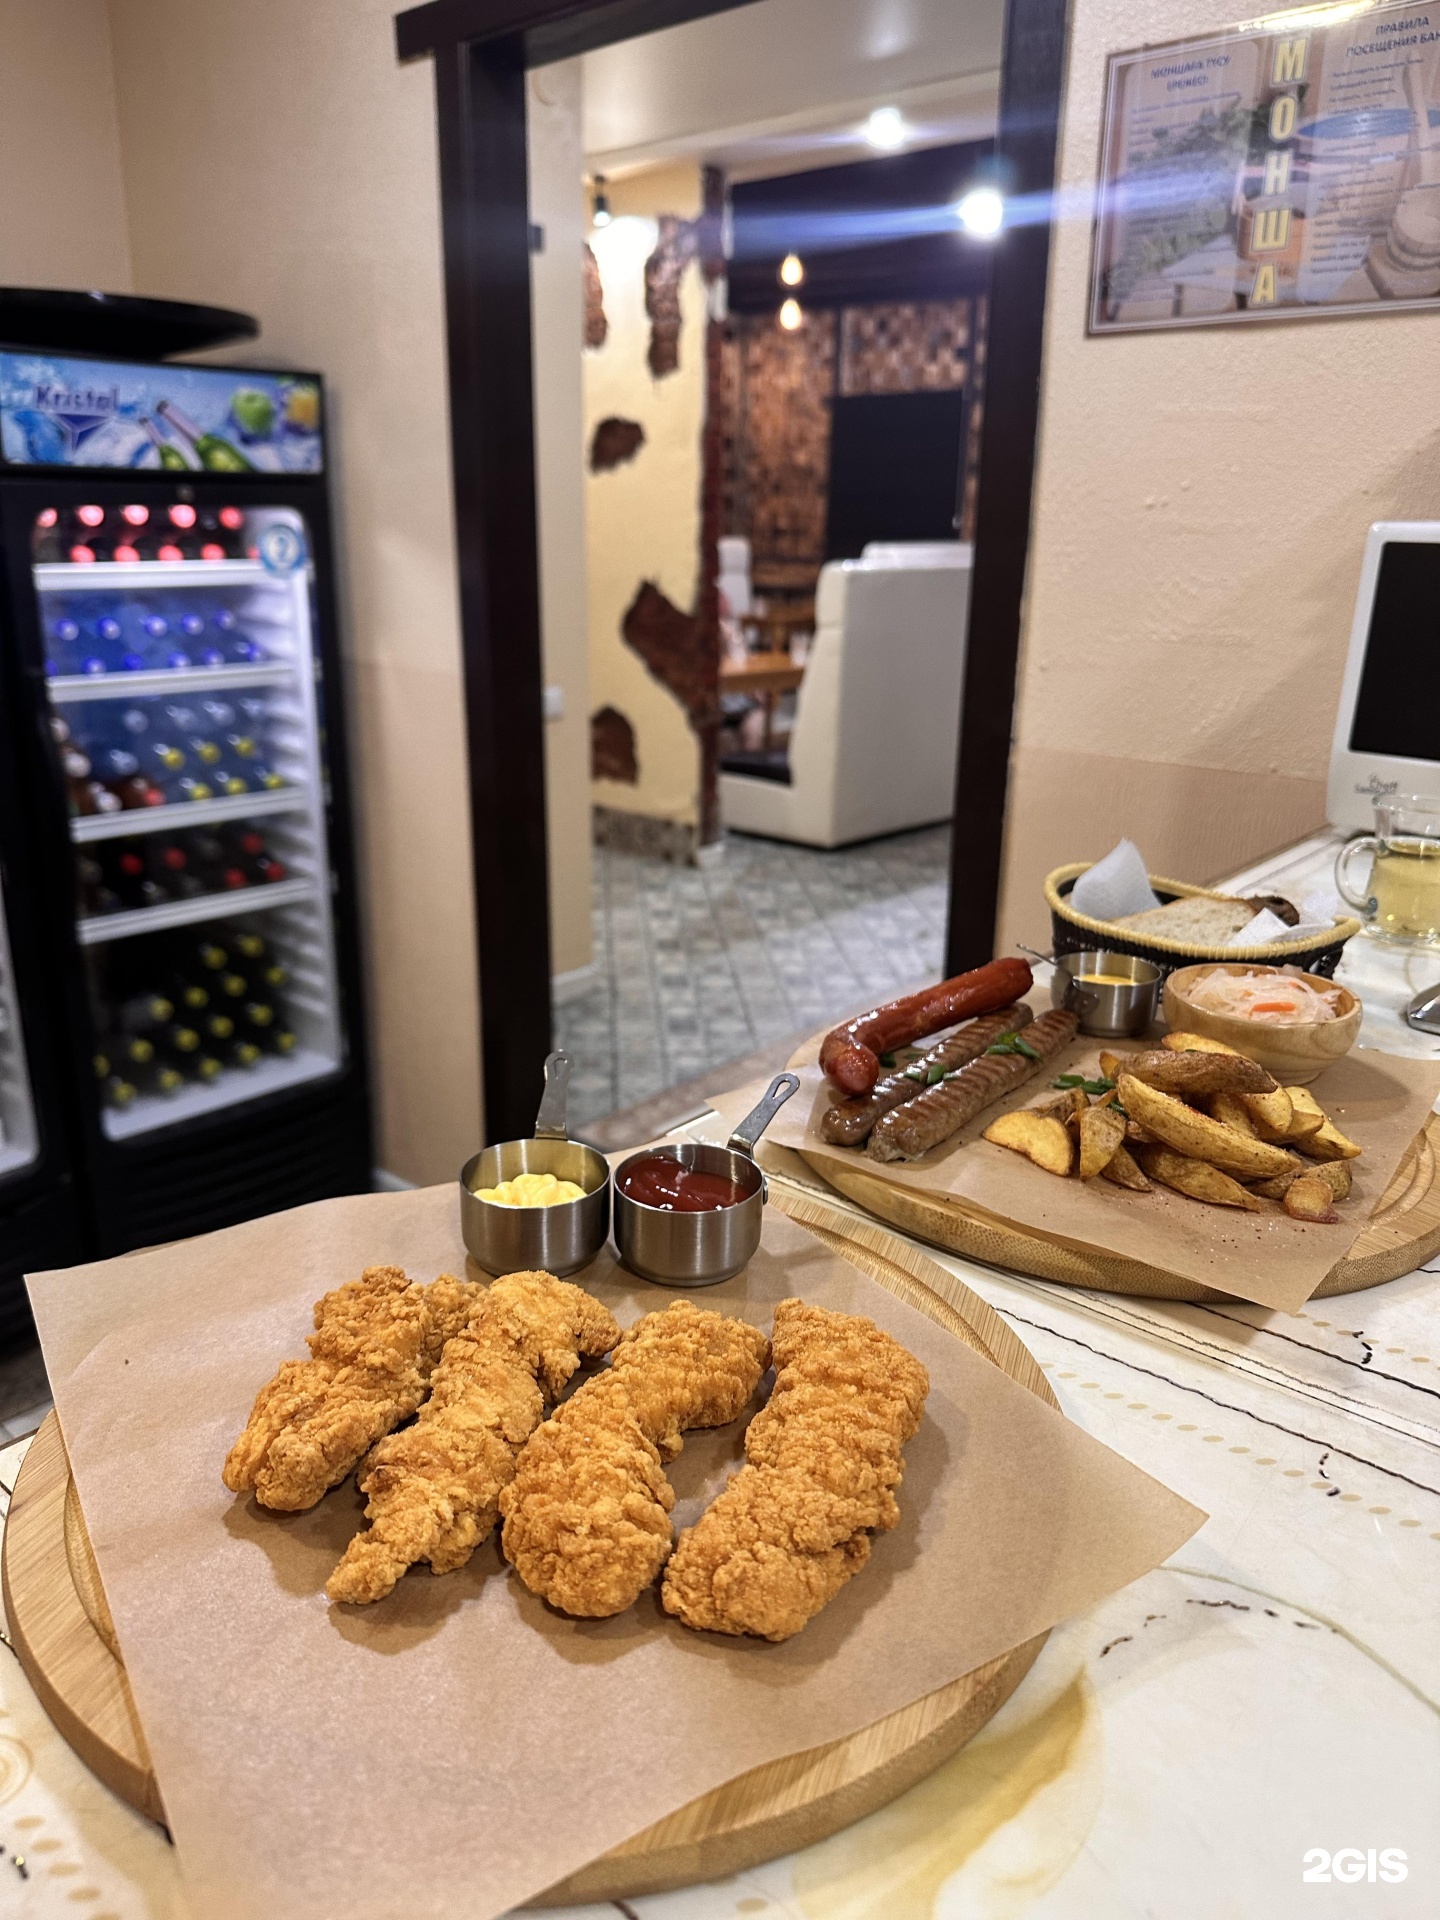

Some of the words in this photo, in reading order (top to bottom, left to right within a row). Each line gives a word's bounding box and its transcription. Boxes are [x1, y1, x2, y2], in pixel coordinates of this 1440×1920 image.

[1375, 16, 1430, 36] ПРАВИЛА
[1346, 35, 1418, 57] ПОСЕЩЕНИЯ
[1251, 37, 1307, 304] МОНША
